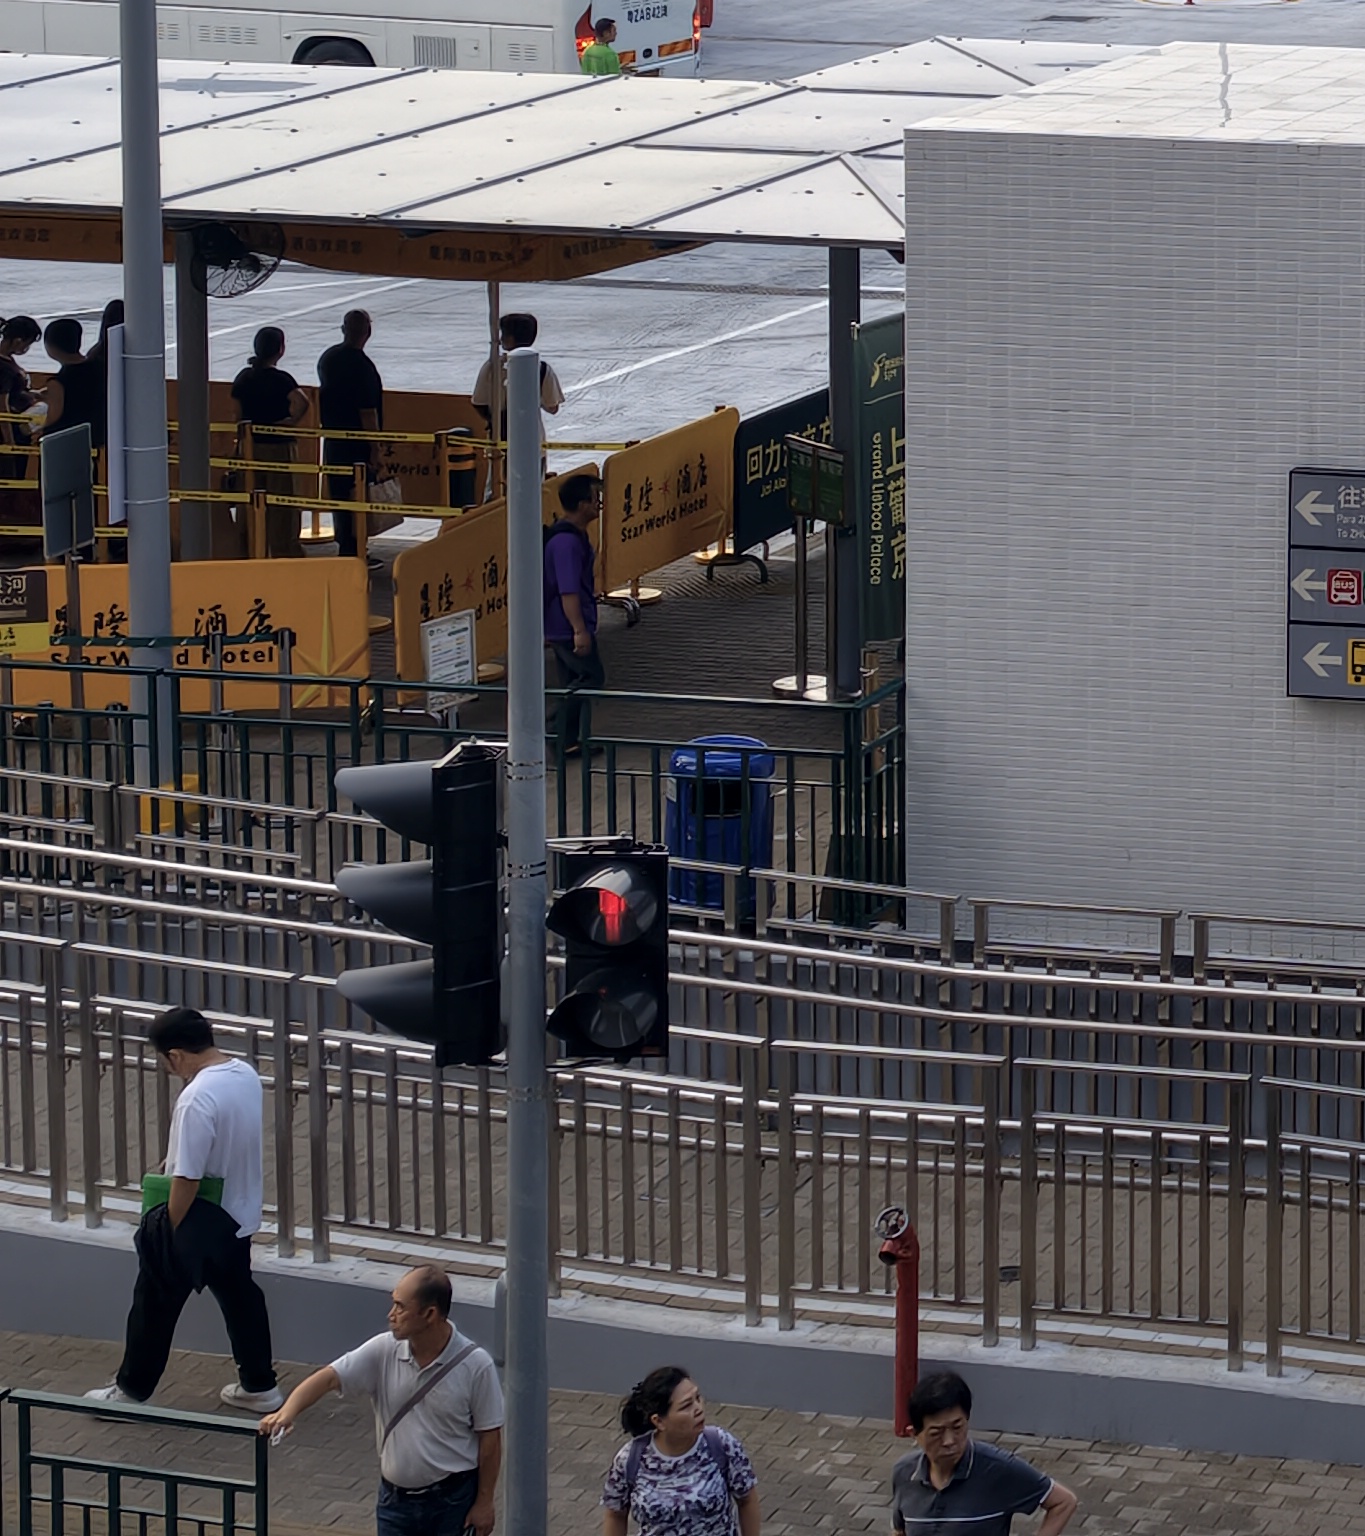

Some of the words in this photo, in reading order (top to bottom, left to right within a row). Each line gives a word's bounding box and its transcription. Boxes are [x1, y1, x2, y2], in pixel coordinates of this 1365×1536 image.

[679, 493, 709, 526] Hotel
[1336, 514, 1357, 525] Para
[1337, 529, 1348, 539] To
